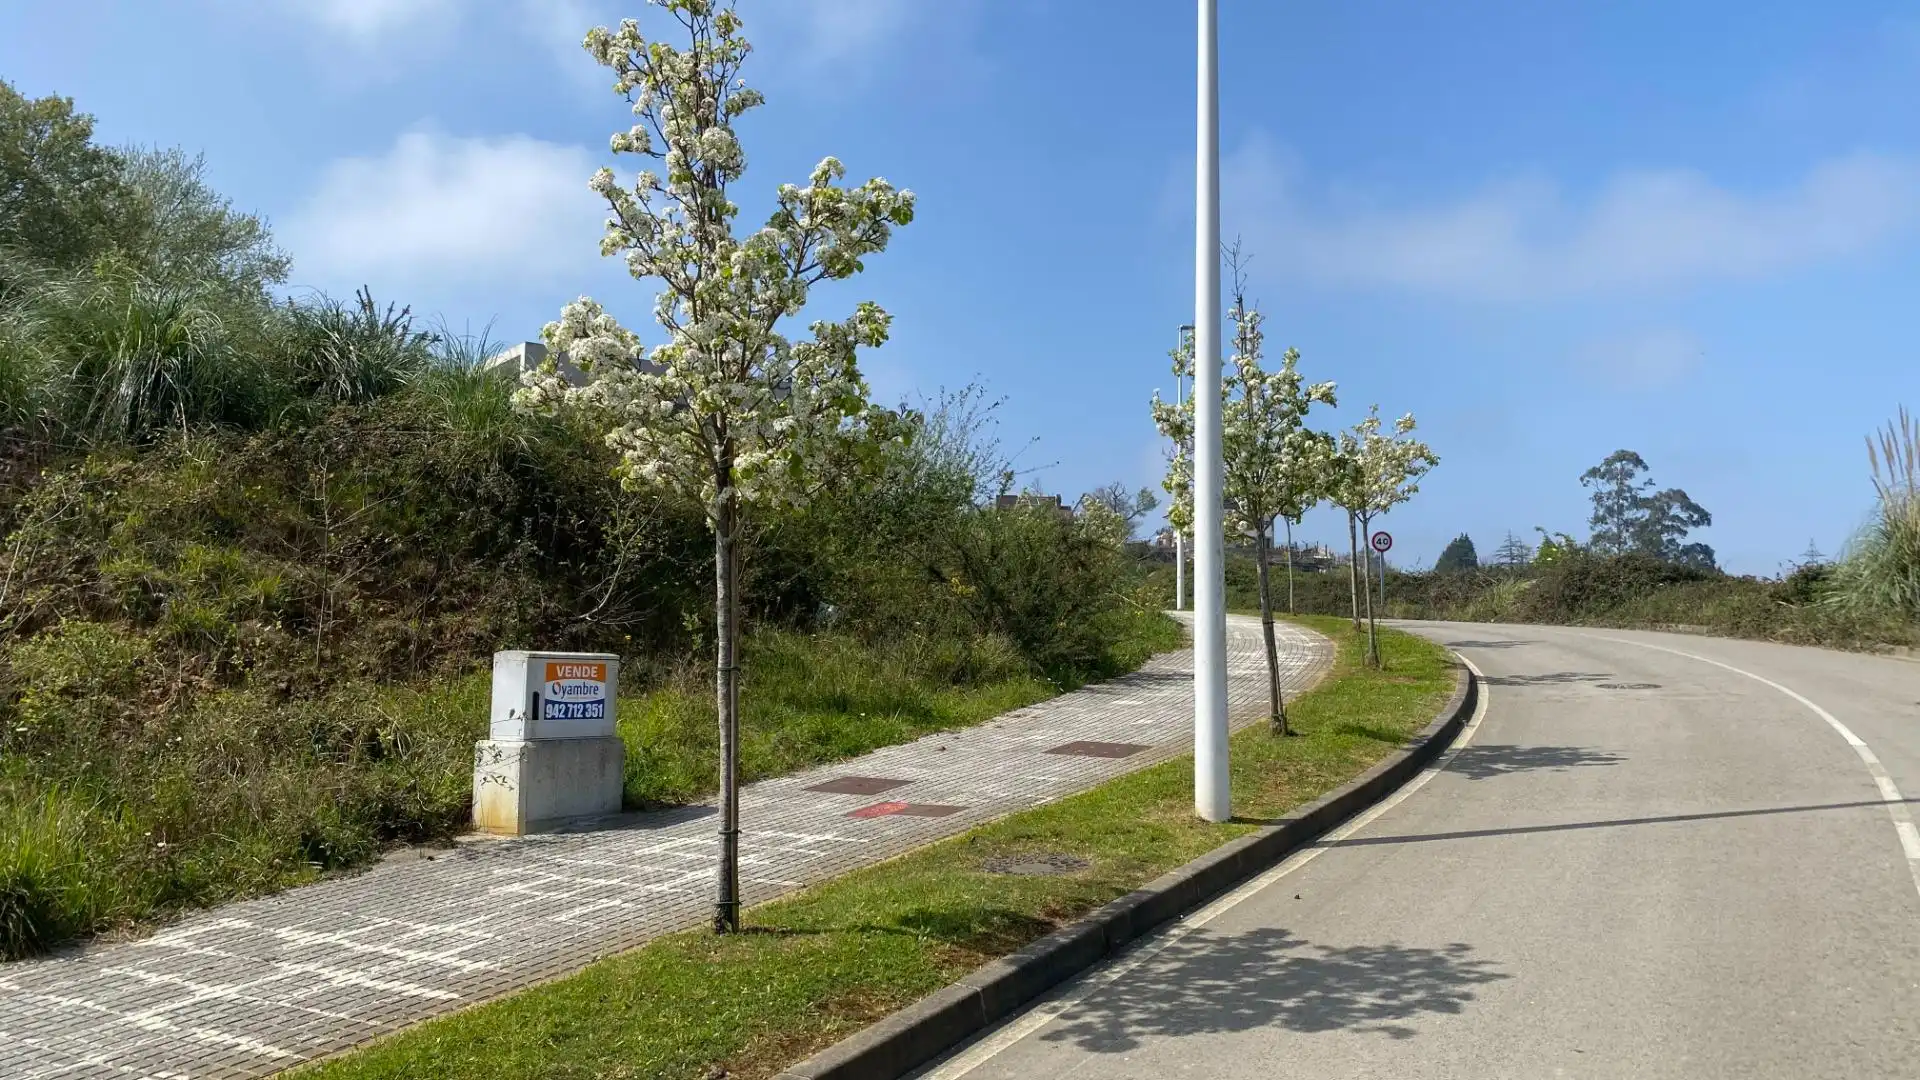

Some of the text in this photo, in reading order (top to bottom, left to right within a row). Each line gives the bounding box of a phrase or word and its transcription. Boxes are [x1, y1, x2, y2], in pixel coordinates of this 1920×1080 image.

[1375, 537, 1389, 546] 40
[556, 664, 599, 678] VENDE
[552, 681, 599, 699] Oyambre
[545, 703, 603, 719] 942 712 351
